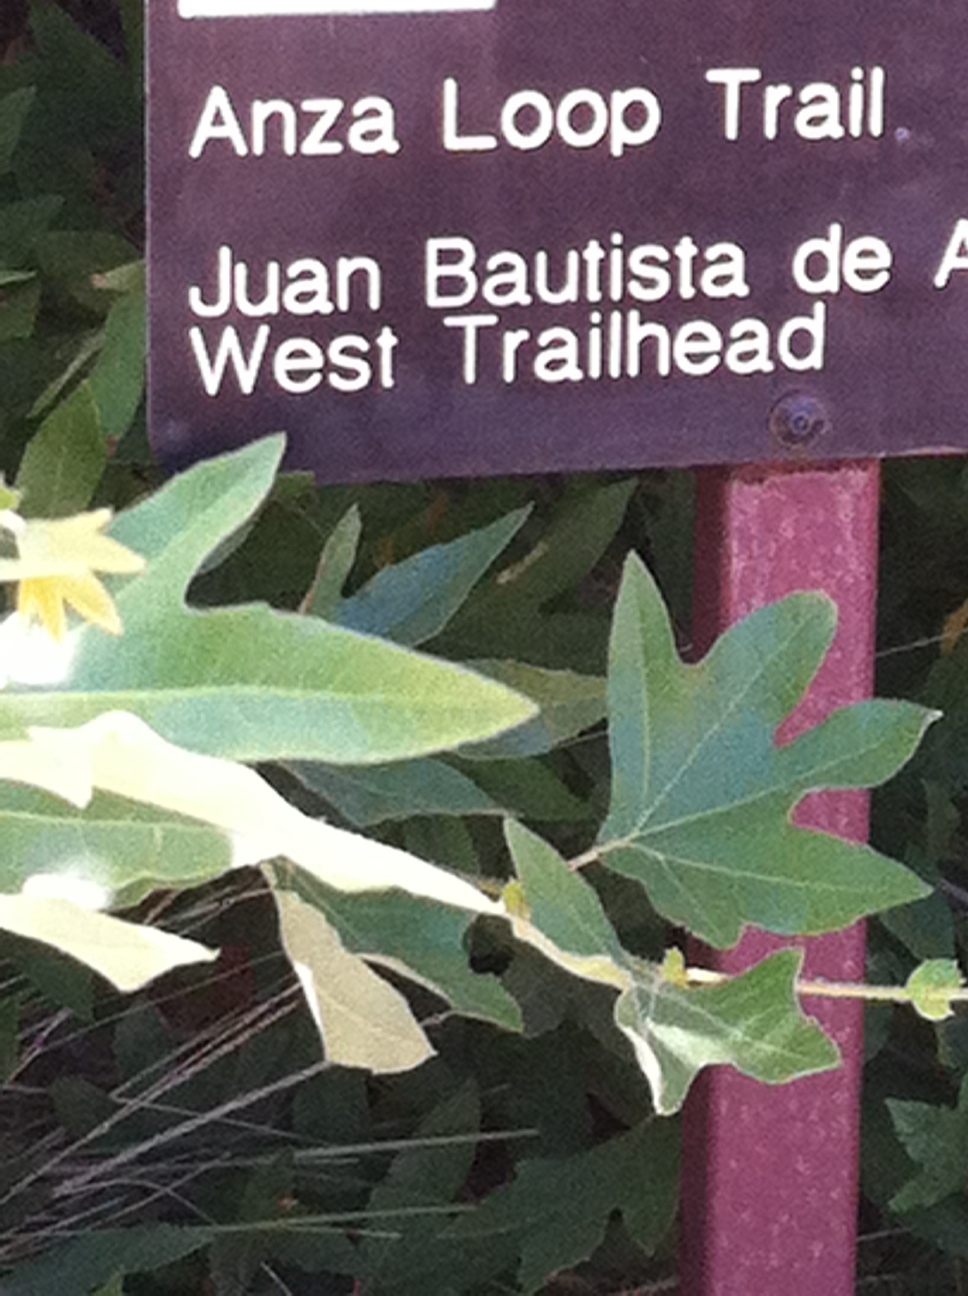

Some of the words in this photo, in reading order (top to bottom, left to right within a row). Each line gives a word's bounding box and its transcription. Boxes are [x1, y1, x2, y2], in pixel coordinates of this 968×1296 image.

[188, 85, 400, 159] Anza
[443, 77, 661, 156] Loop
[705, 66, 884, 140] Trail
[188, 245, 381, 318] Juan
[425, 232, 750, 308] Bautista
[792, 223, 892, 294] de
[188, 326, 398, 396] West
[443, 300, 826, 384] Trailhead
